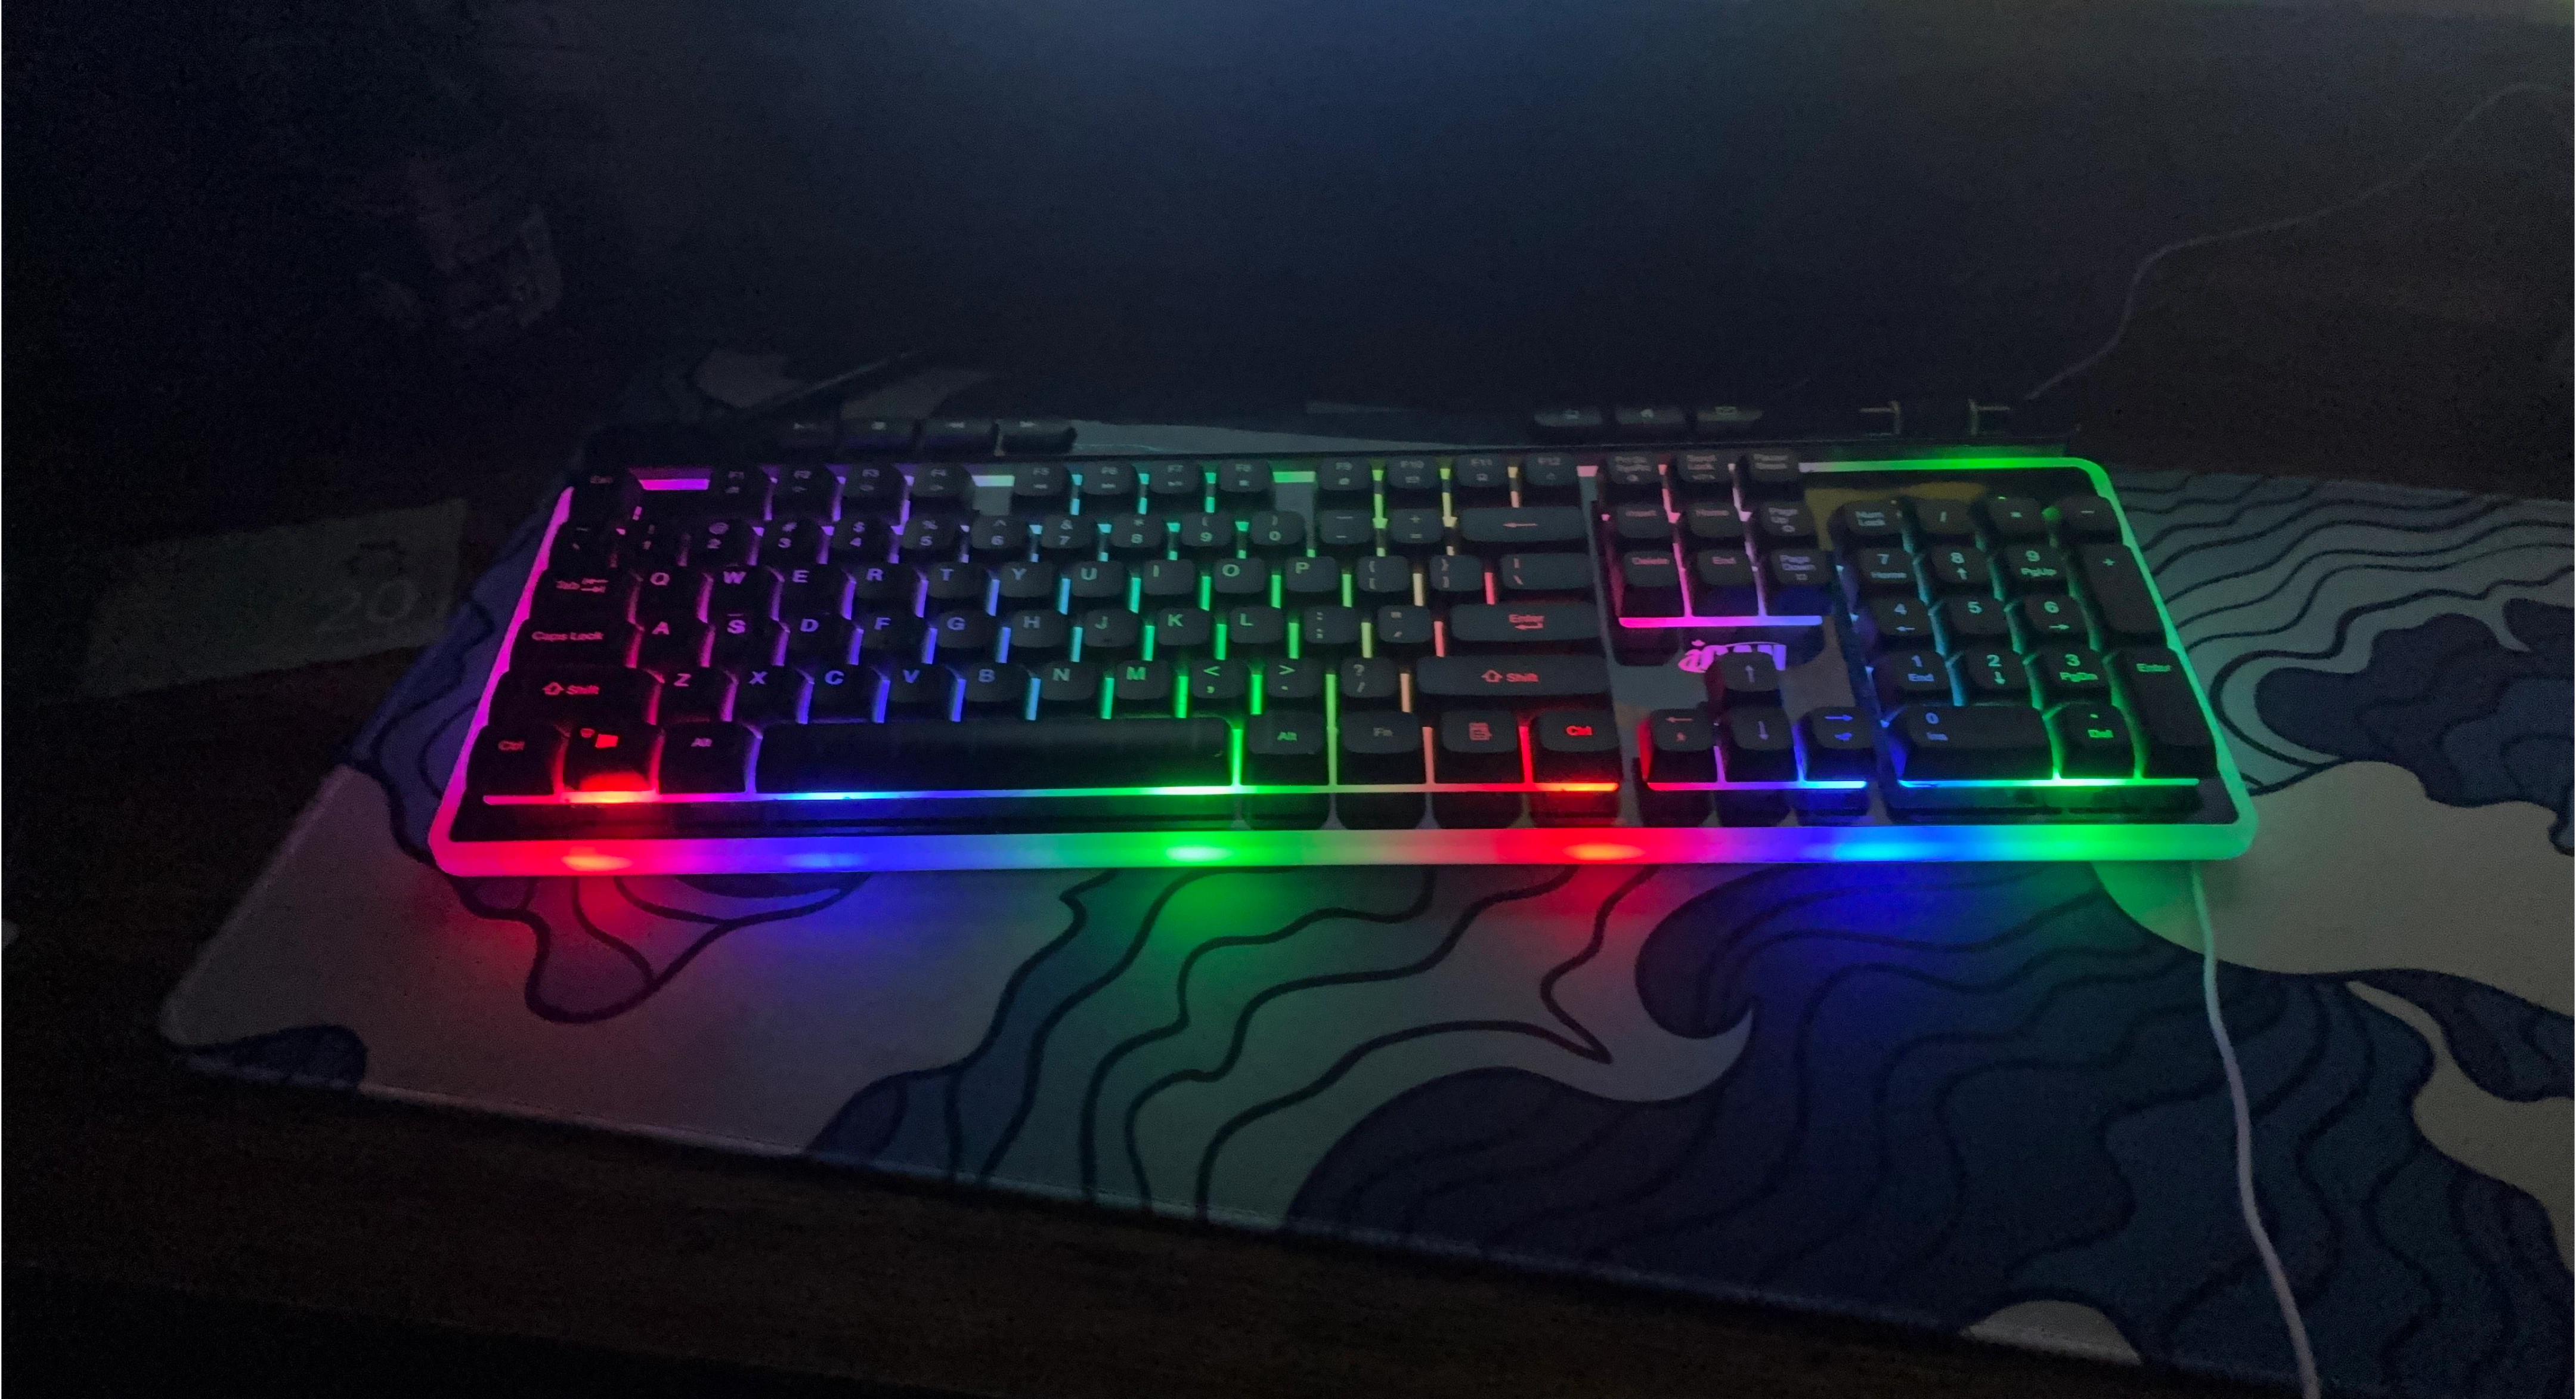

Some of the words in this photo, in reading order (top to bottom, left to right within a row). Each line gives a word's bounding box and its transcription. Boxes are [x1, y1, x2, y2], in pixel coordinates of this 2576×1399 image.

[1336, 462, 1352, 471] F9
[1400, 460, 1424, 469] F10
[1538, 457, 1561, 466] F12
[1101, 466, 1117, 475] F6
[1166, 465, 1183, 473] F7
[853, 522, 865, 533] $
[850, 538, 861, 546] 4
[920, 536, 932, 546] 5
[991, 536, 1003, 545] 6
[1059, 536, 1070, 545] 7
[1131, 534, 1143, 543] 8
[1200, 532, 1212, 541] 9
[1269, 531, 1281, 541] 0
[707, 538, 721, 549] 2
[778, 538, 791, 548] 3
[1878, 553, 1889, 564] 7
[1950, 552, 1964, 564] 8
[2026, 550, 2040, 562] 9
[1012, 568, 1026, 580] Y
[1080, 568, 1097, 580] U
[1222, 564, 1240, 577] O
[1296, 562, 1309, 574] P
[651, 572, 670, 586] Q
[724, 572, 745, 584] W
[792, 569, 808, 583] E
[866, 568, 883, 581] R
[940, 568, 953, 581] T
[1894, 604, 1906, 614] 4
[1968, 602, 1981, 614] 5
[2044, 601, 2059, 613] 6
[875, 617, 890, 630] F
[946, 617, 965, 630] G
[1023, 616, 1040, 628] H
[1095, 617, 1107, 629] J
[1168, 614, 1182, 626] K
[1240, 614, 1253, 626] L
[1509, 614, 1544, 624] Enter
[652, 622, 669, 634] A
[728, 620, 745, 634] S
[800, 619, 819, 632] D
[531, 630, 568, 642] Caps
[570, 630, 604, 641] Lock
[1912, 655, 1922, 667] 1
[1987, 655, 2001, 667] 2
[2066, 654, 2080, 666] 3
[1126, 667, 1145, 680] M
[2137, 663, 2171, 672] Enter
[674, 673, 691, 686] Z
[750, 671, 767, 684] X
[825, 670, 844, 685] C
[903, 670, 919, 683] V
[979, 669, 995, 683] B
[1053, 668, 1070, 681] N
[1506, 673, 1538, 682] Shift
[1908, 673, 1934, 682] End
[566, 685, 599, 695] Shift
[1925, 713, 1939, 724] 0
[1277, 732, 1297, 741] Alt
[1374, 728, 1392, 736] Fn
[1566, 726, 1592, 736] Ctrl
